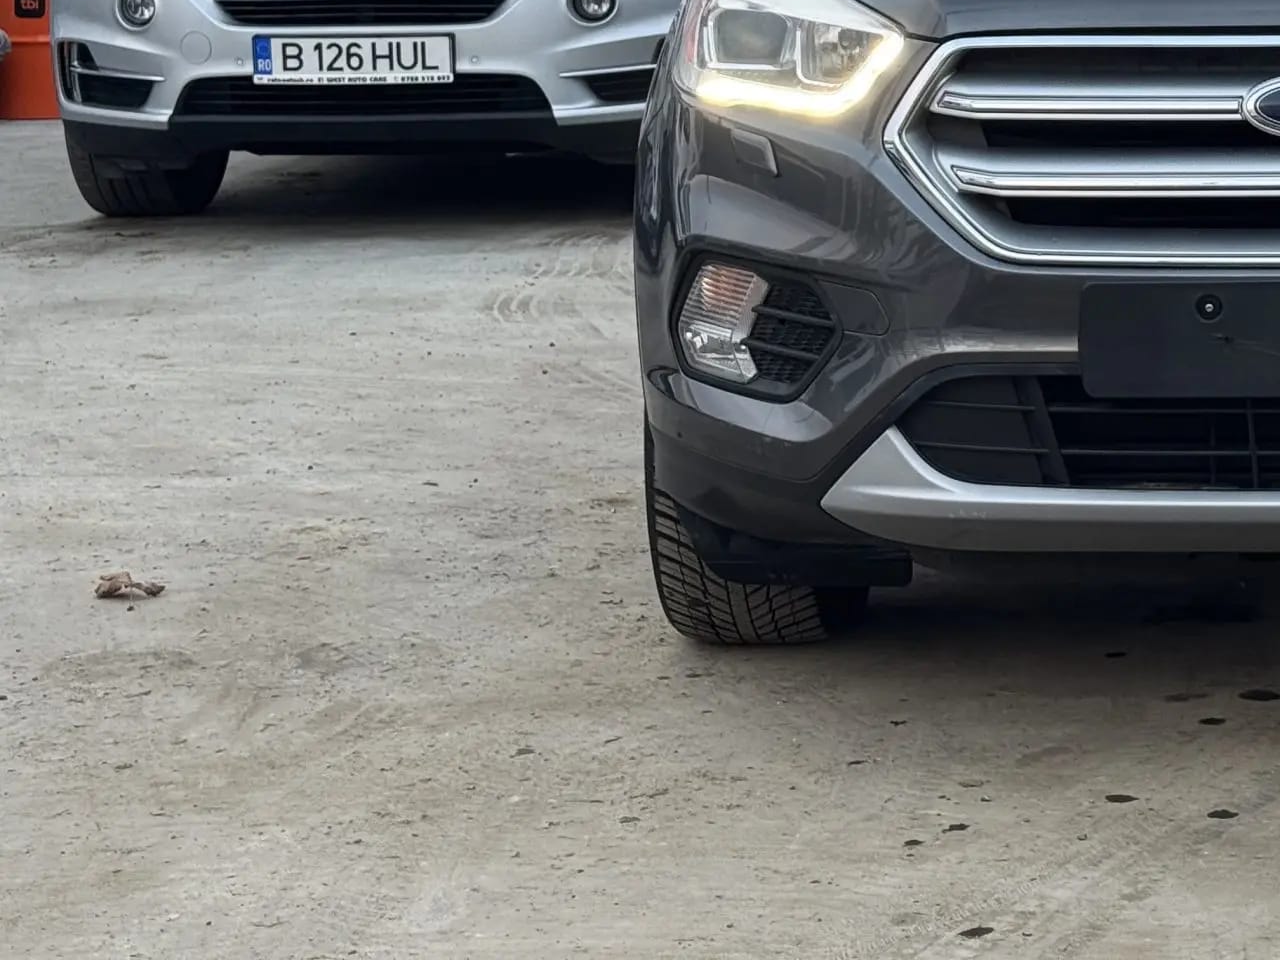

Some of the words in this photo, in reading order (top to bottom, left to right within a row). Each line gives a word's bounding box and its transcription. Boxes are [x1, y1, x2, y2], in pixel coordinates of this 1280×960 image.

[257, 58, 272, 72] RO
[281, 42, 304, 72] B
[313, 42, 364, 72] 126
[371, 41, 439, 71] HUL
